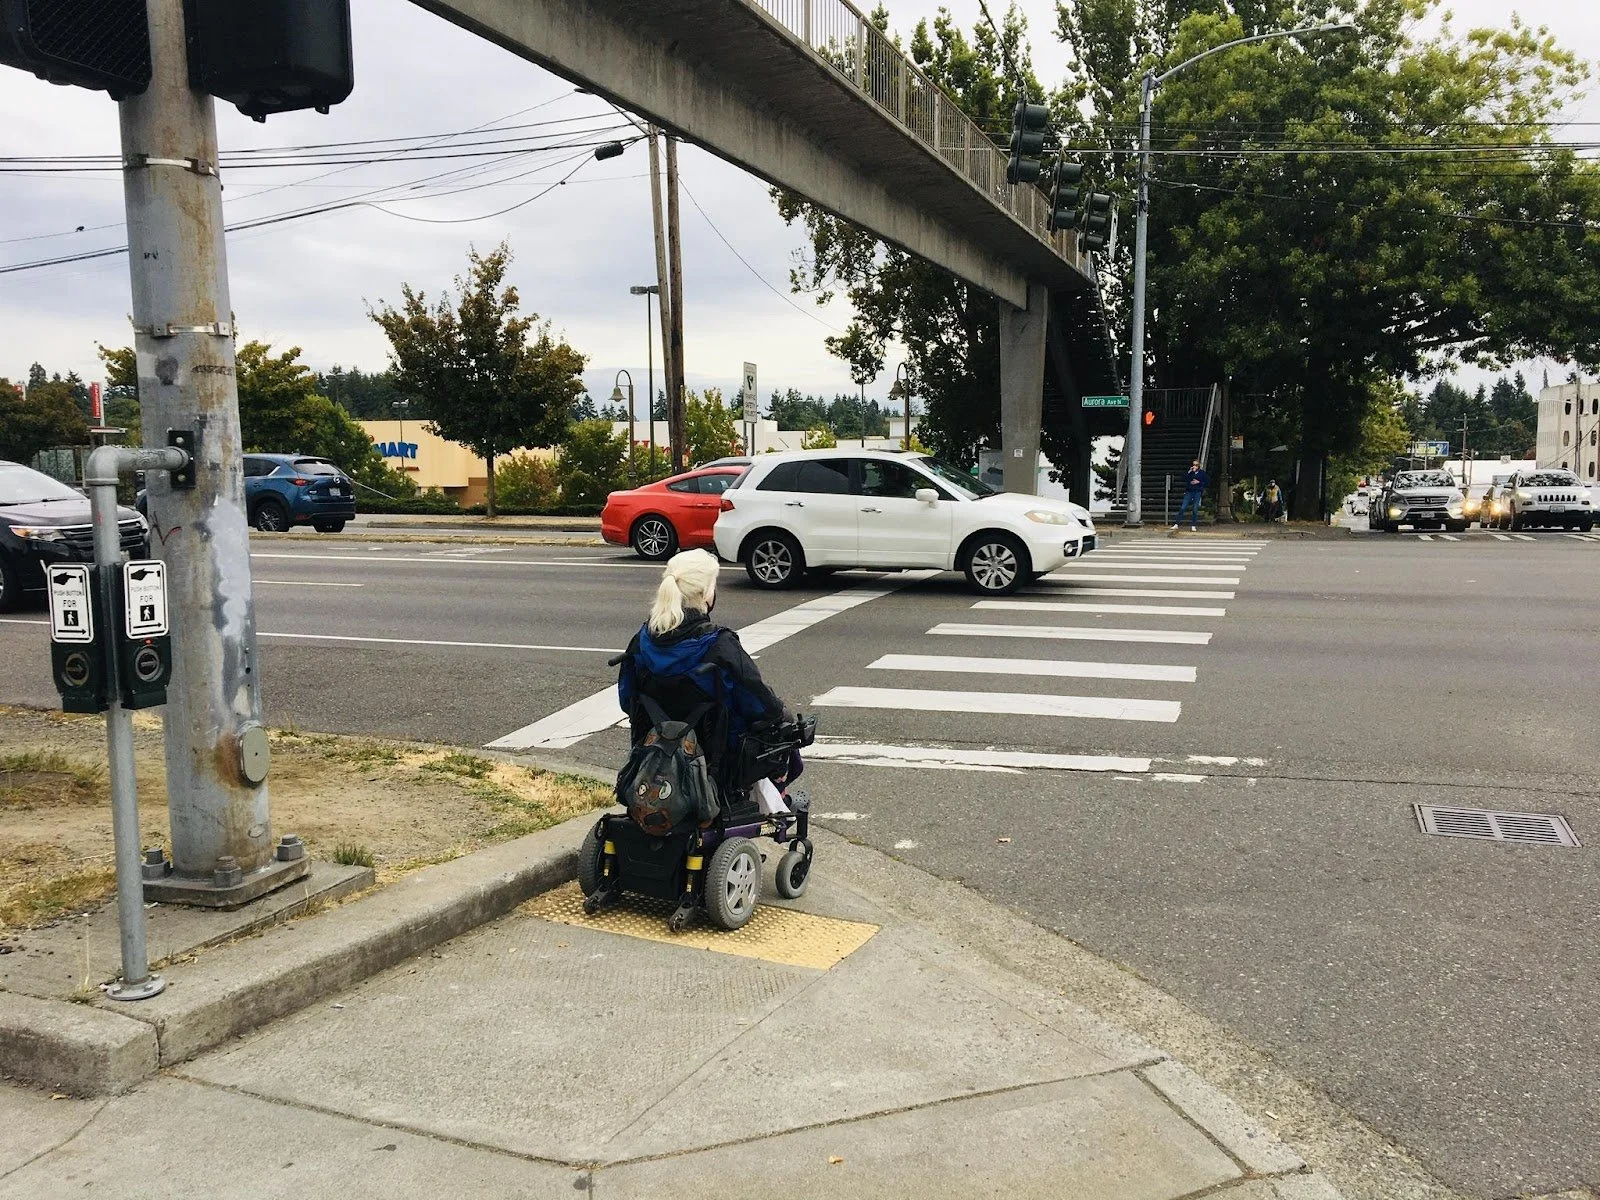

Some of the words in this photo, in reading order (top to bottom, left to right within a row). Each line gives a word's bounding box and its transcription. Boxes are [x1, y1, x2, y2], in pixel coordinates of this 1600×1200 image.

[1083, 397, 1105, 406] Aurora
[63, 599, 77, 608] FOR
[140, 595, 153, 603] FOR
